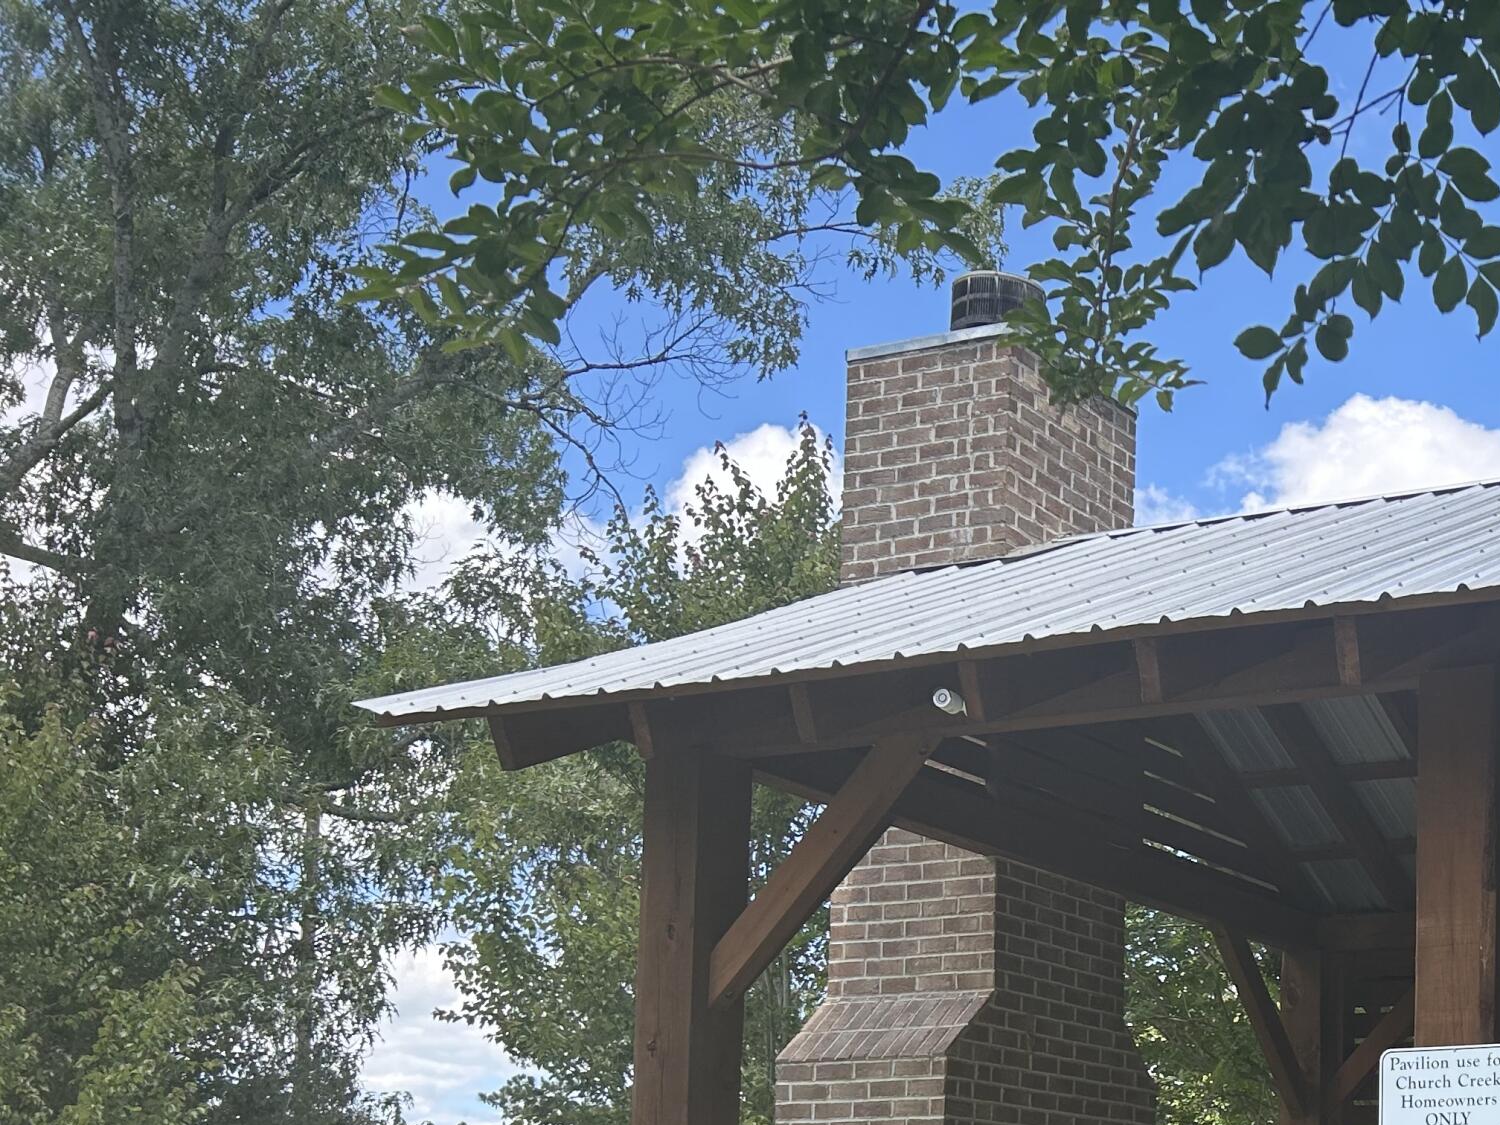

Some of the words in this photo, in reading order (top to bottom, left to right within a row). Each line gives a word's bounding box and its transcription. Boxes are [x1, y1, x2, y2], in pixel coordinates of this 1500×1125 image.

[1390, 1056, 1449, 1071] Pavilion
[1457, 1057, 1480, 1068] use
[1396, 1075, 1451, 1089] Church
[1458, 1072, 1500, 1087] Creek
[1401, 1095, 1497, 1108] Homeowners
